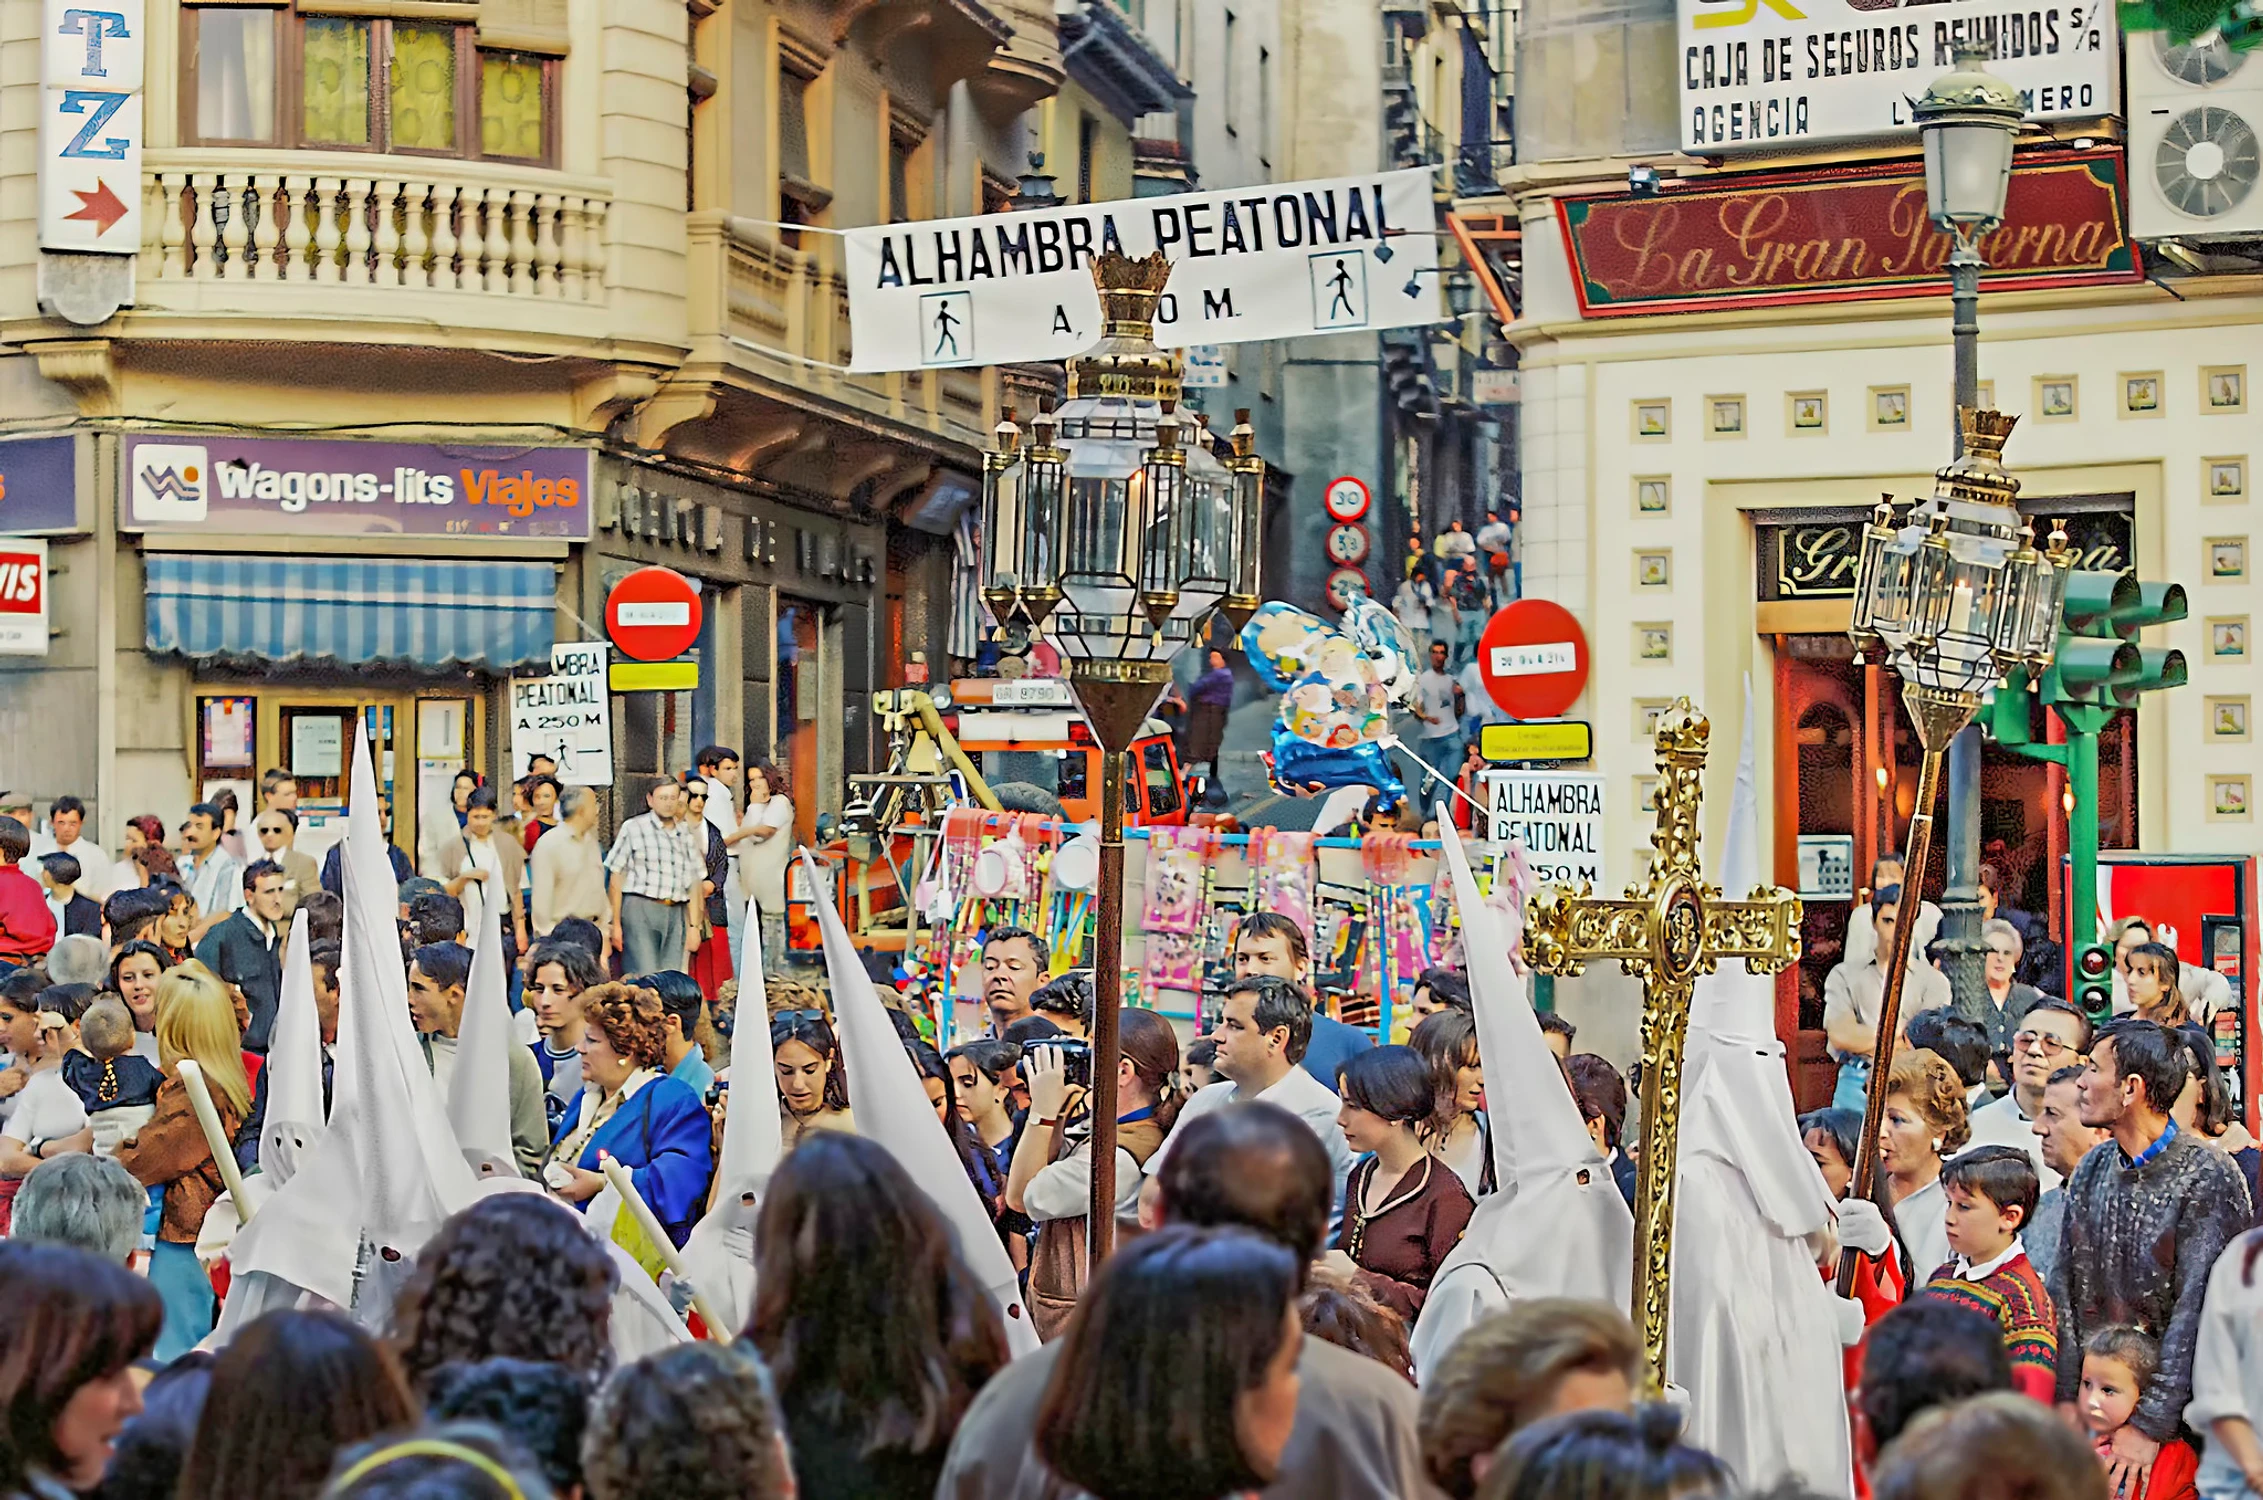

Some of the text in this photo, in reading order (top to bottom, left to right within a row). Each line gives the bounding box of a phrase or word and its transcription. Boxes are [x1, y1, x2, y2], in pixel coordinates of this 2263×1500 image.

[1686, 41, 1748, 90] CAJA
[1763, 36, 1792, 83] DE
[1806, 24, 1919, 79] SEGUROS
[1692, 96, 1809, 145] AGENCIA
[2019, 83, 2093, 113] MERO
[876, 183, 1406, 290] ALHAMBRA PEATONAL
[1610, 202, 1717, 292] La
[1719, 194, 1874, 286] Gran
[213, 459, 455, 512] Wagons-lits
[459, 468, 580, 518] Viajes
[1335, 490, 1360, 506] 30
[515, 680, 600, 709] PEATONAL
[517, 713, 601, 730] A 250 M
[1496, 782, 1601, 815] ALHAMBRA
[1529, 864, 1598, 882] 50 M
